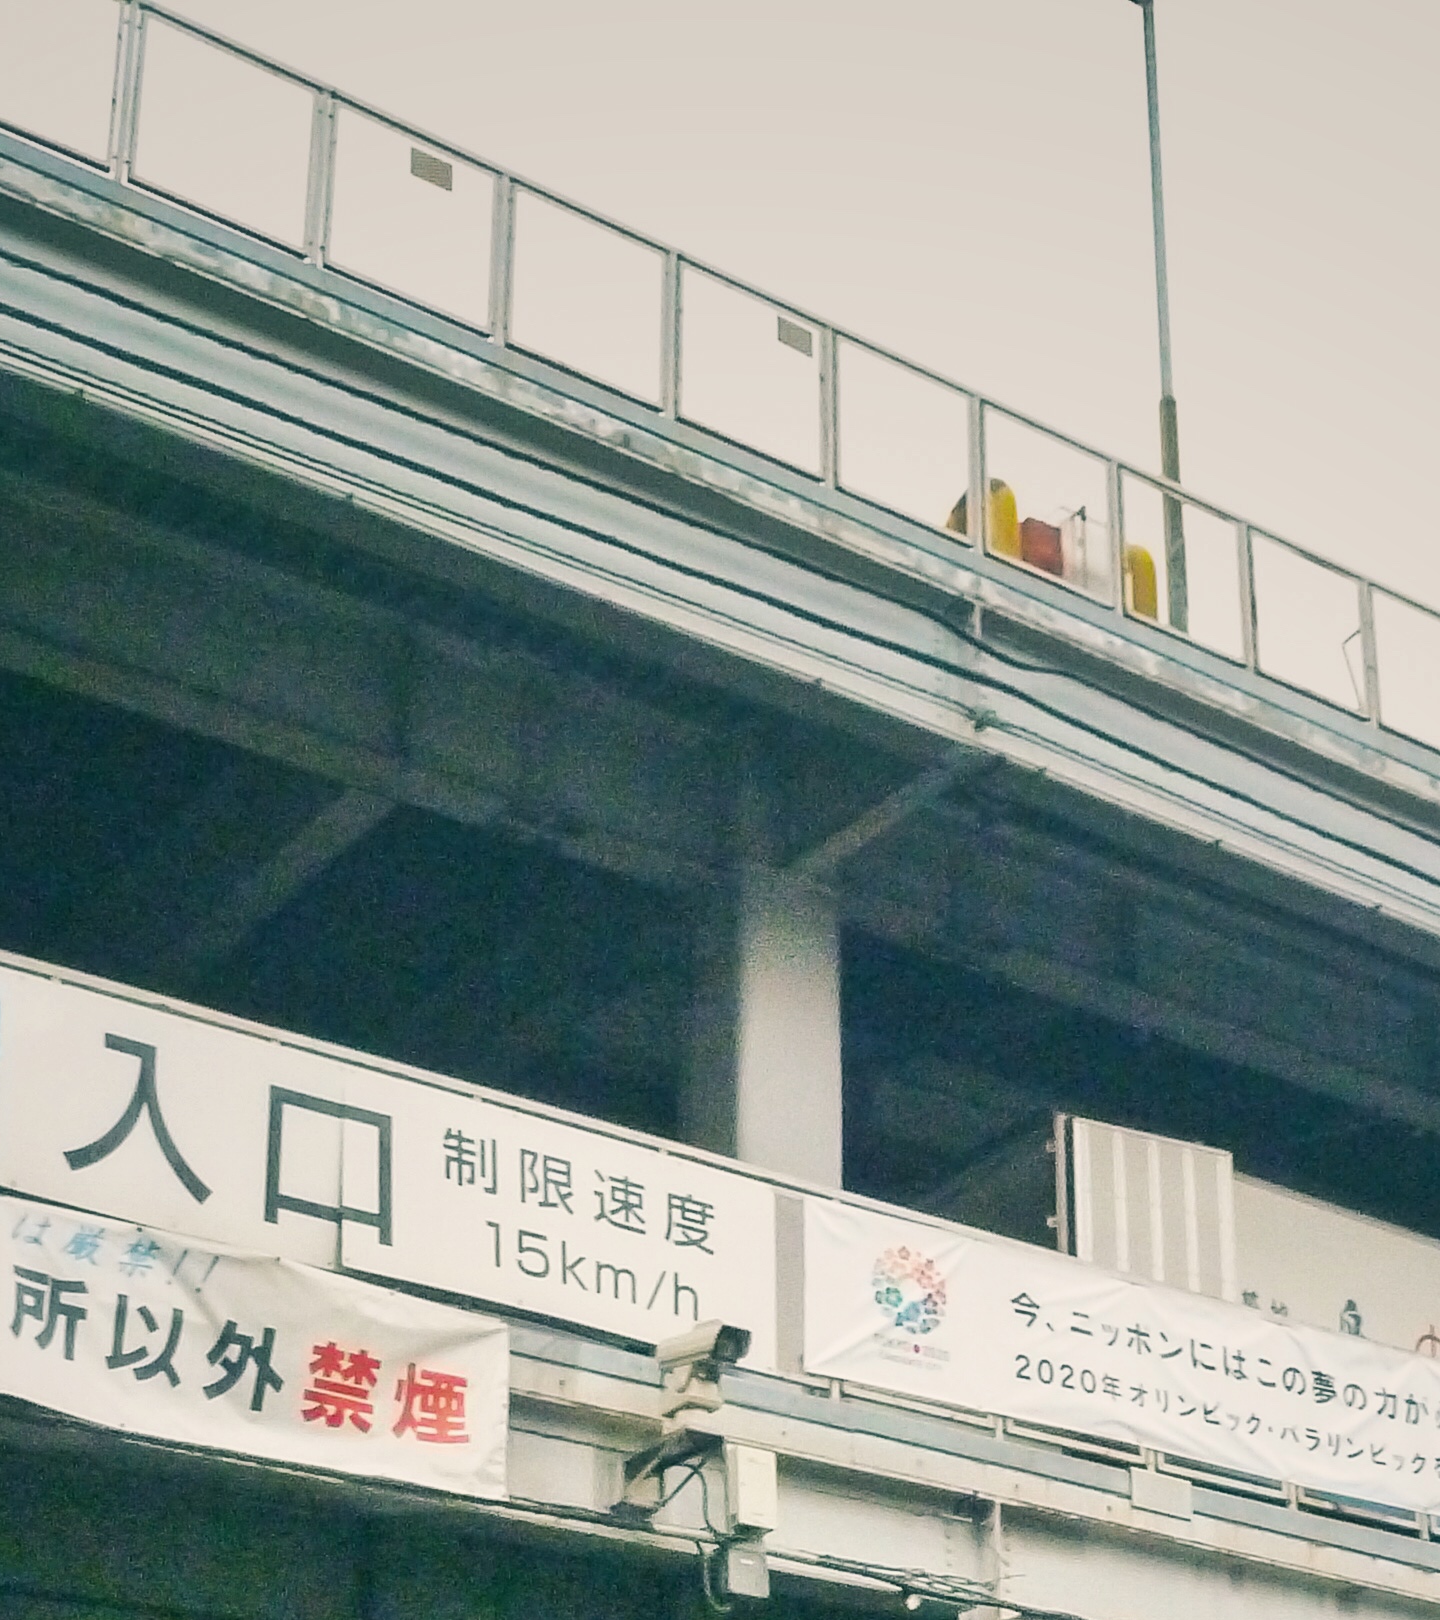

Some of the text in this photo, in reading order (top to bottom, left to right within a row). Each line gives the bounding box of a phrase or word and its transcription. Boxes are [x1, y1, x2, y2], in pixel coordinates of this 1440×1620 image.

[64, 1032, 393, 1247] 入口
[442, 1127, 716, 1255] 制限速度
[485, 1220, 700, 1321] 15km/h
